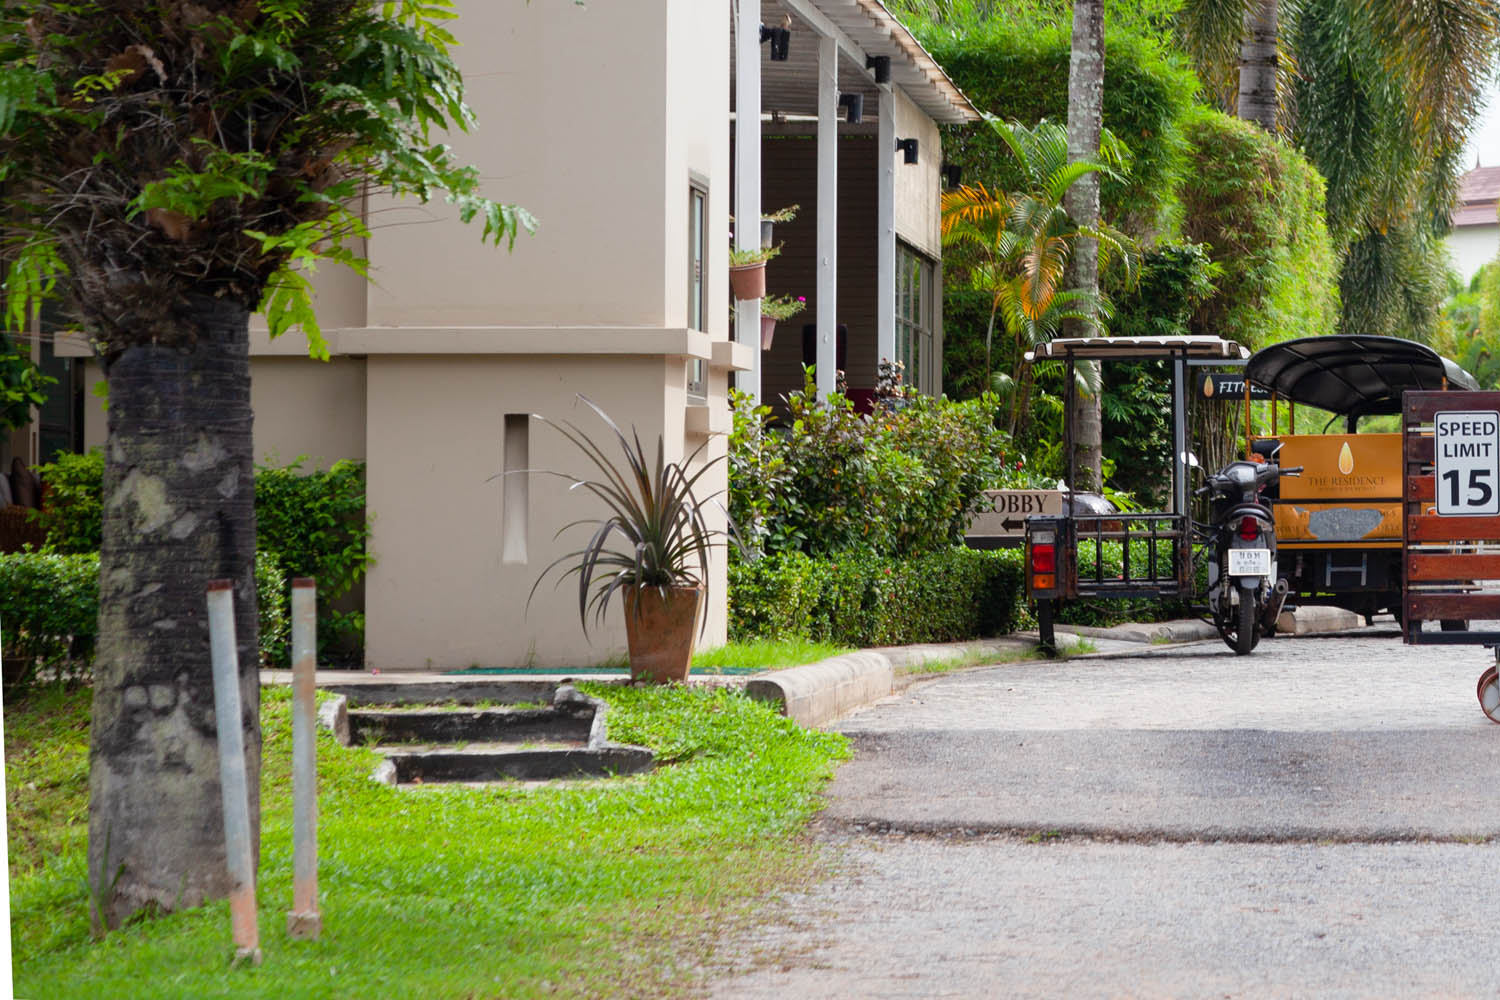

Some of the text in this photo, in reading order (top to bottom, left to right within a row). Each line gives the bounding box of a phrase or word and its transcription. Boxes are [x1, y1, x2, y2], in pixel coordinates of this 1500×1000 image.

[1219, 381, 1269, 394] FITNE
[1440, 422, 1495, 436] SPEED
[1444, 443, 1492, 457] LIMIT
[1309, 476, 1327, 486] THE
[1443, 469, 1492, 506] 15
